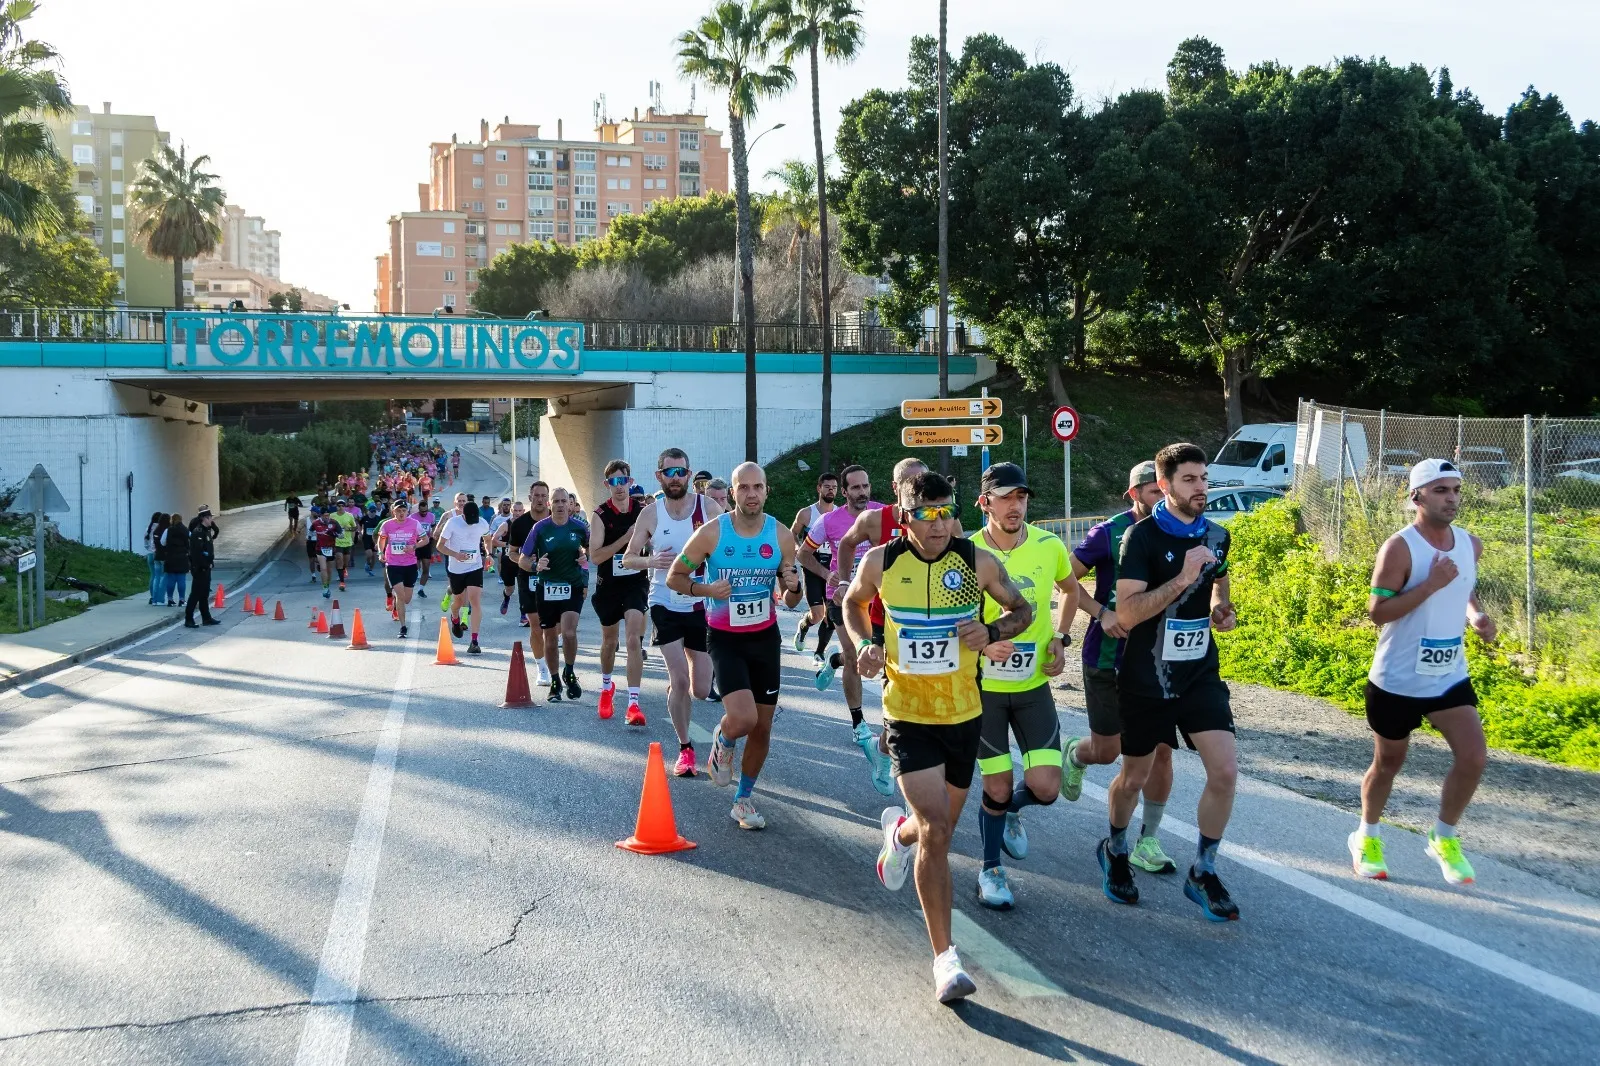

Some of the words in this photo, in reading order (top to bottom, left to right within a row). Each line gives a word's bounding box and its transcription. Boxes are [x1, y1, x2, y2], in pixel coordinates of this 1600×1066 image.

[177, 318, 575, 369] TORREMOLINOS
[546, 585, 570, 595] 1719
[736, 600, 763, 616] 811
[1173, 630, 1204, 648] 672
[908, 640, 949, 659] 137
[1420, 646, 1459, 664] 2091
